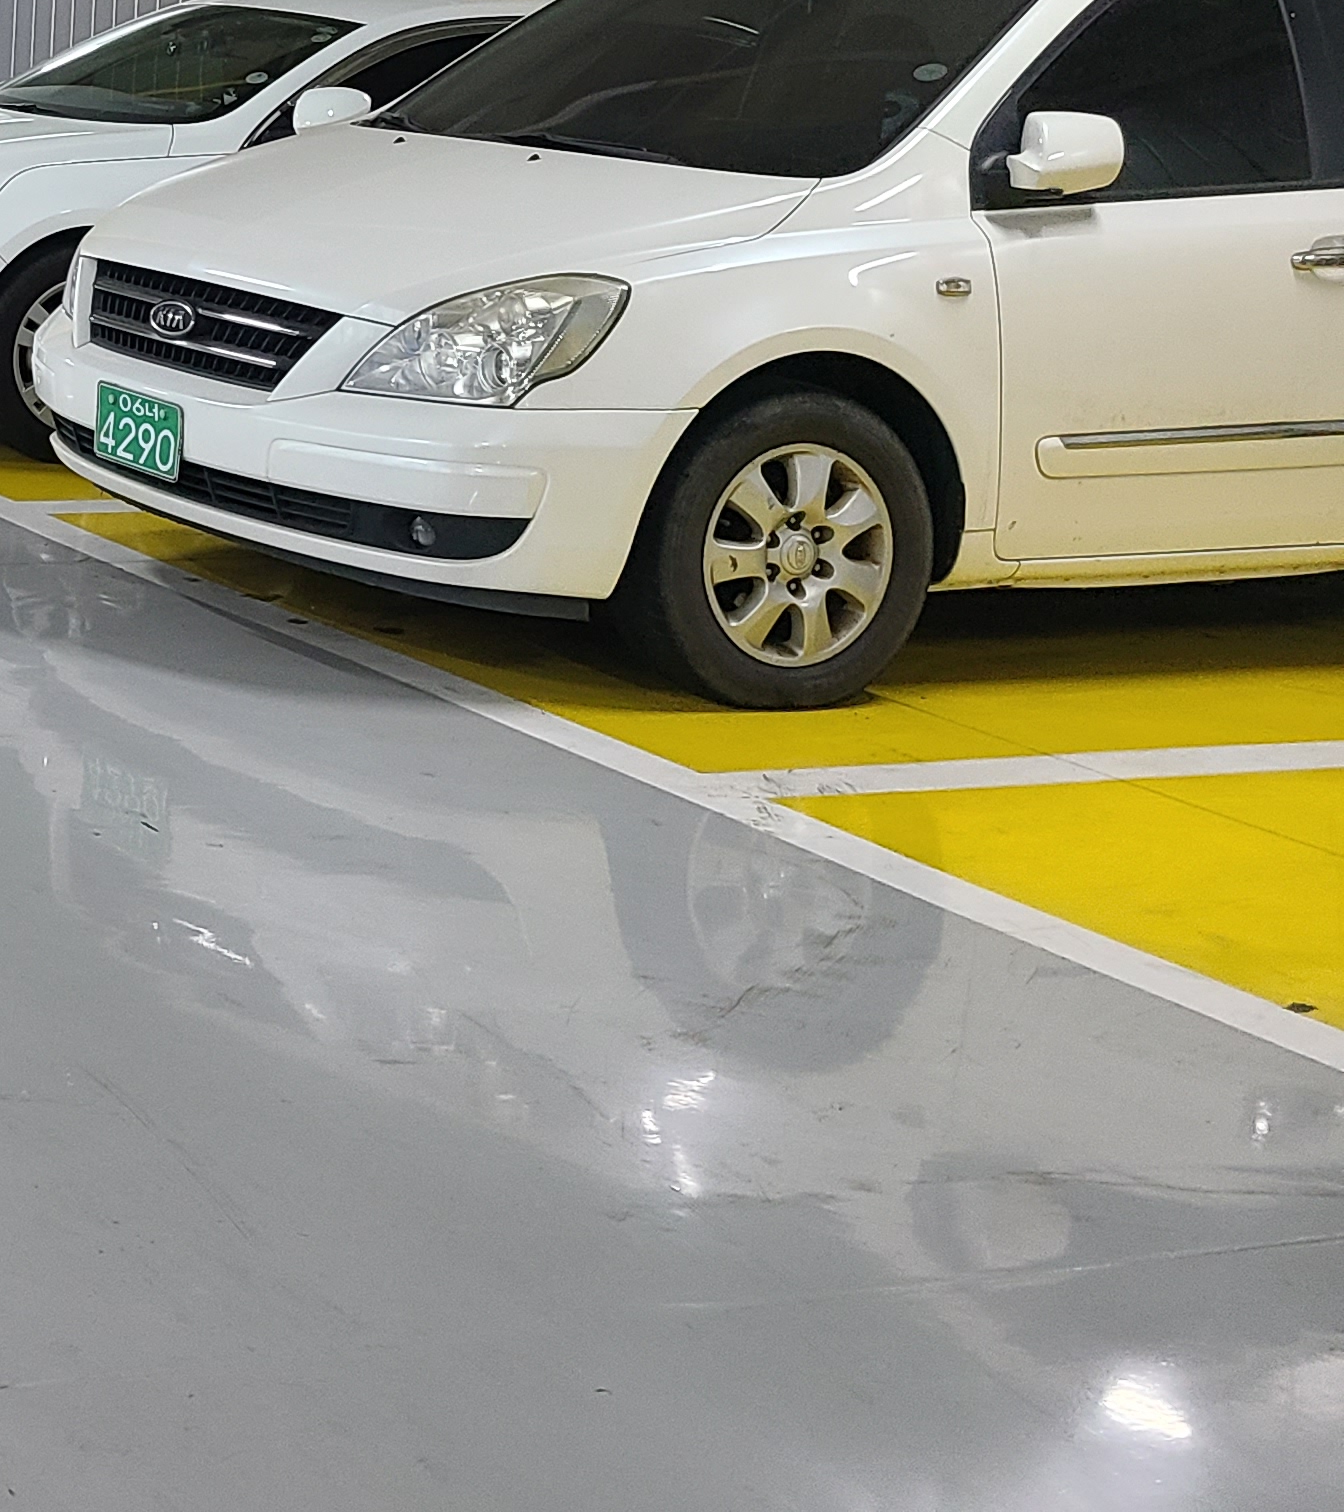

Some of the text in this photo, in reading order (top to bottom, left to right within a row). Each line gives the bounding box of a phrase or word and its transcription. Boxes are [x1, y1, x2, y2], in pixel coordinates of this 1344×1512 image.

[155, 306, 186, 330] KIA
[118, 393, 159, 422] 06너
[99, 411, 176, 472] 4290
